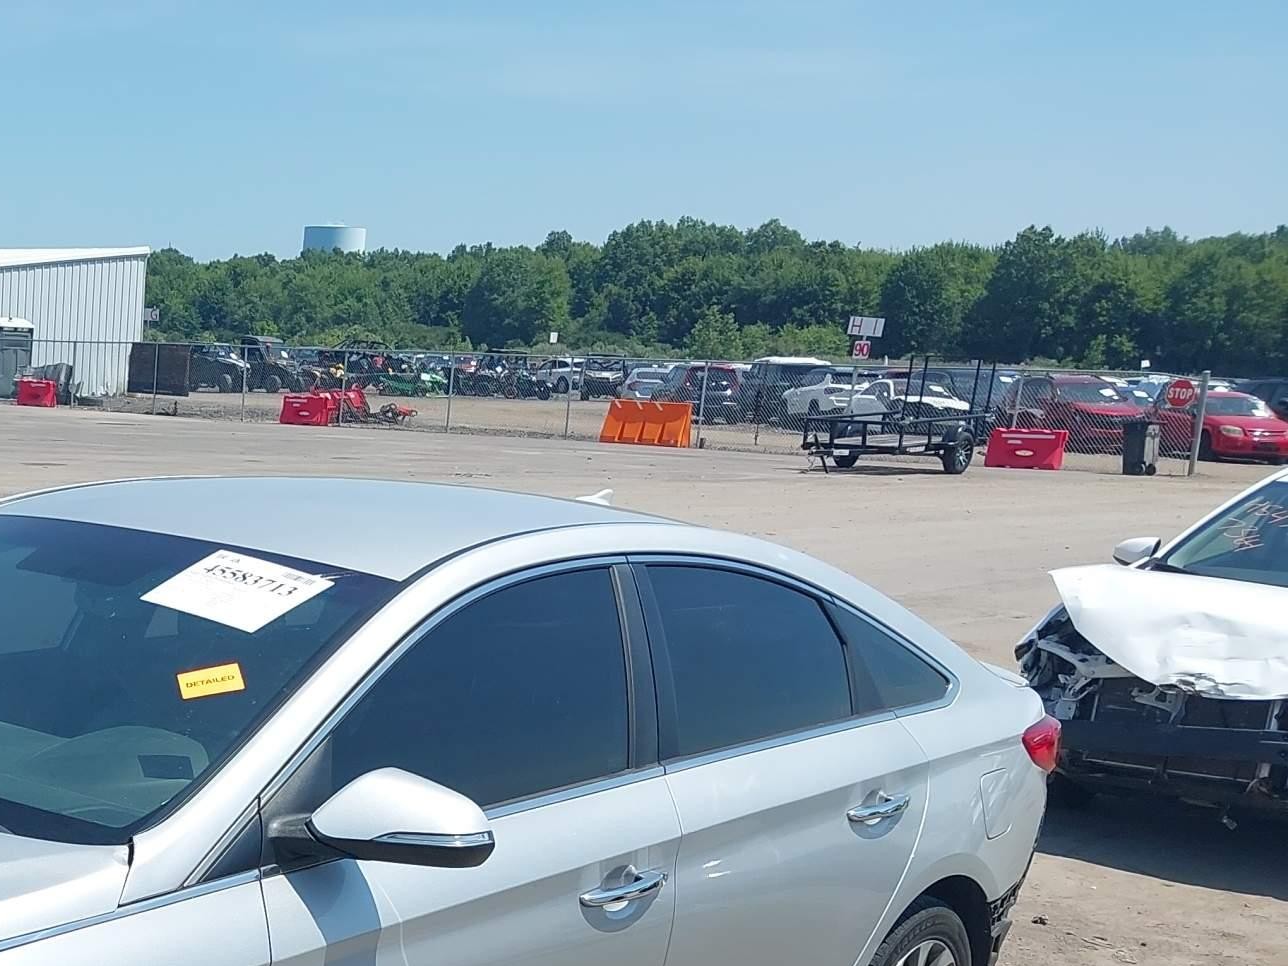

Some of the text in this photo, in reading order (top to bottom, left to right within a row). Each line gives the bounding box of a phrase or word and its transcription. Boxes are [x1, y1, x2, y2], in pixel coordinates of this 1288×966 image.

[851, 317, 863, 334] H
[854, 343, 870, 357] 90
[1168, 387, 1193, 400] STOP
[204, 565, 299, 596] 45583713
[186, 674, 235, 688] DETAILED
